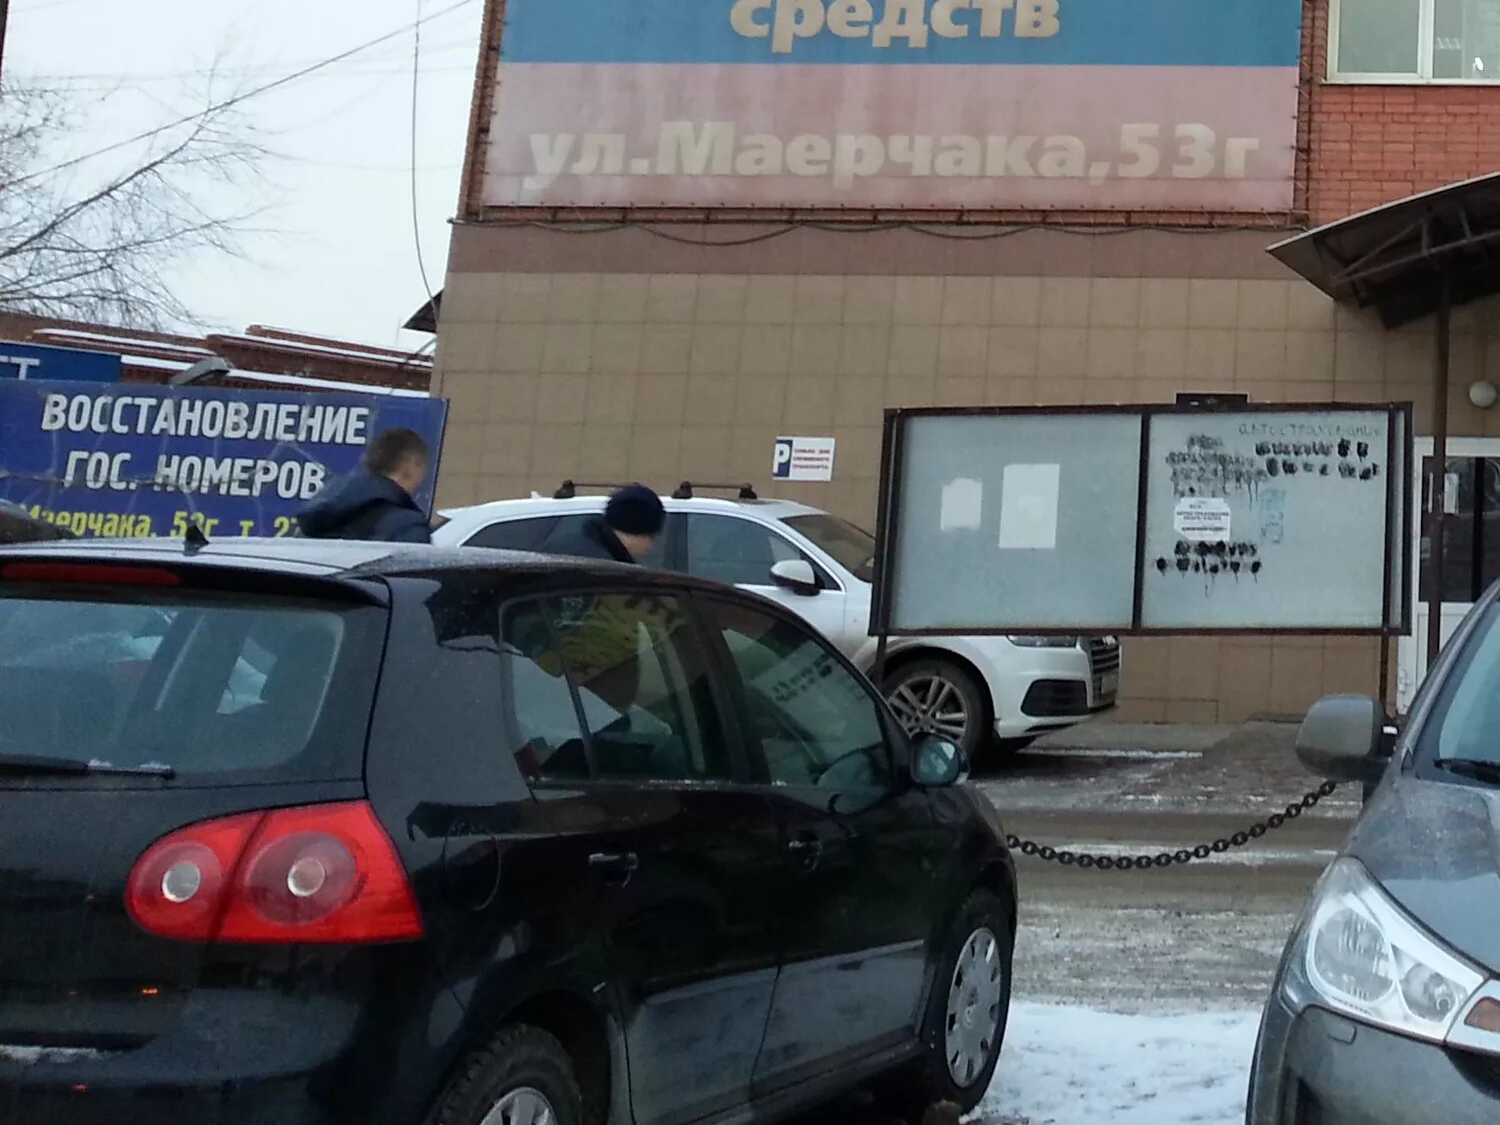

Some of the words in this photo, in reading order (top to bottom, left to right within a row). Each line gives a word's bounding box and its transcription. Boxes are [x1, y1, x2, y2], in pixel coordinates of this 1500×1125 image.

[40, 393, 370, 445] ВОССТАНОВЛЕНИЕ
[63, 451, 137, 492] ГОС.
[152, 453, 327, 501] НОМЕРОВ
